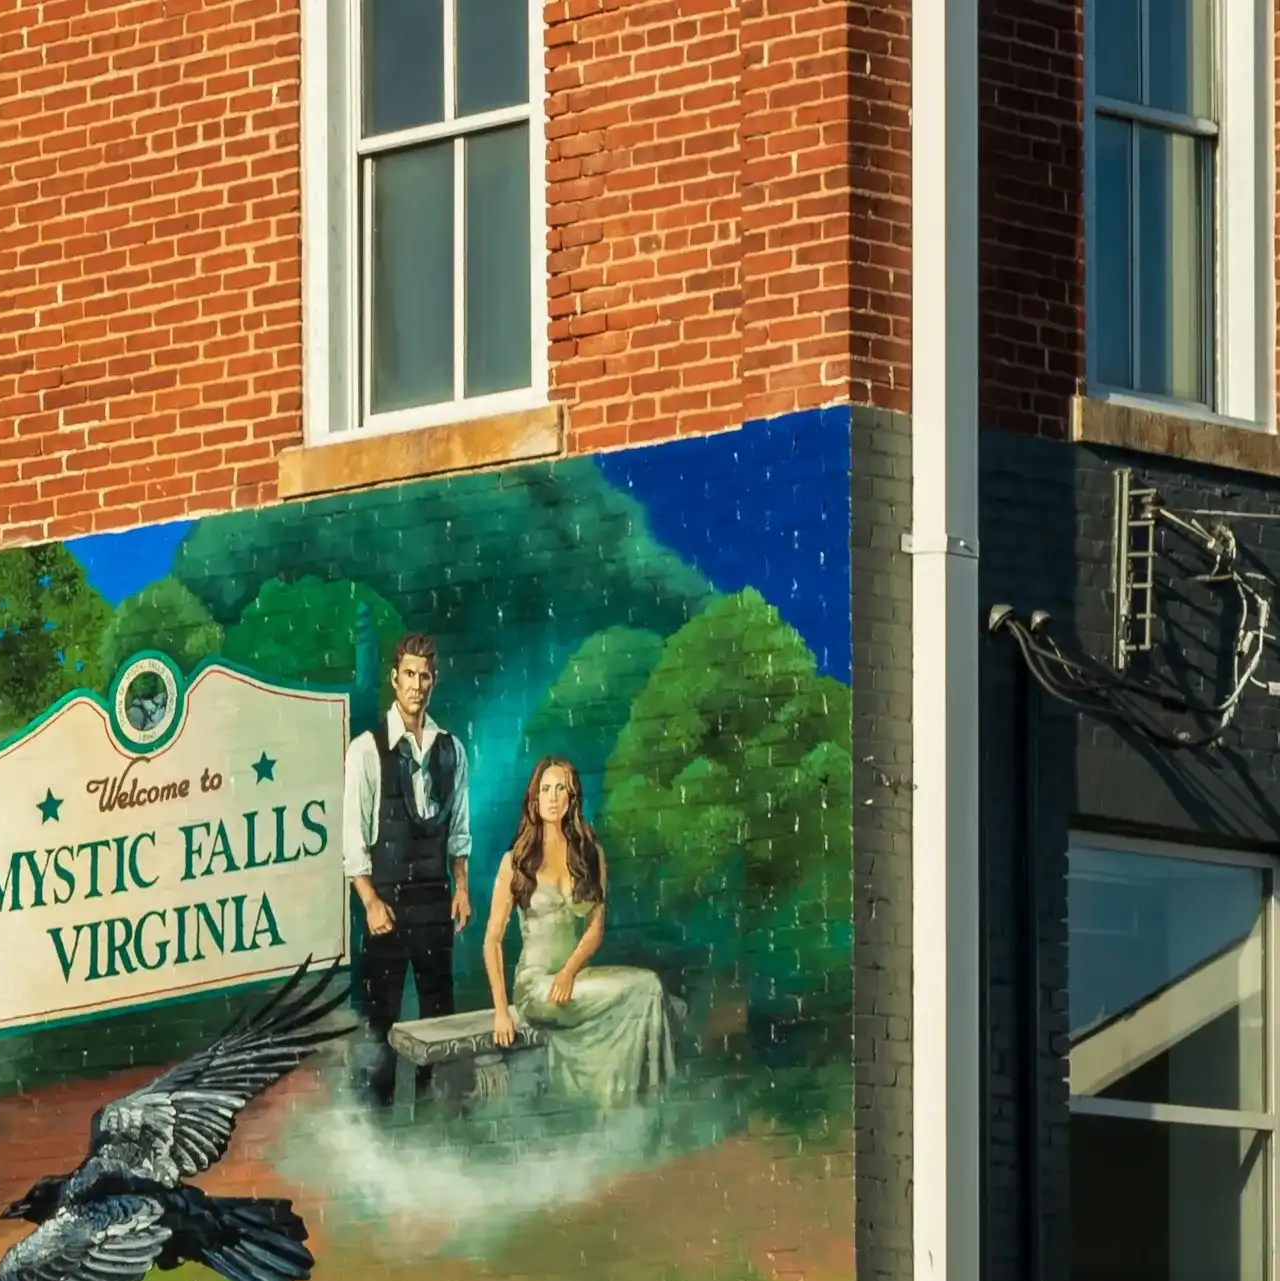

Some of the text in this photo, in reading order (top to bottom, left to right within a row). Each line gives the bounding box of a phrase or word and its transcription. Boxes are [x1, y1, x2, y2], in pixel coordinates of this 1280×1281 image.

[87, 756, 223, 813] Welcome to
[178, 799, 329, 882] FALLS
[46, 891, 286, 984] VIRGINIA
